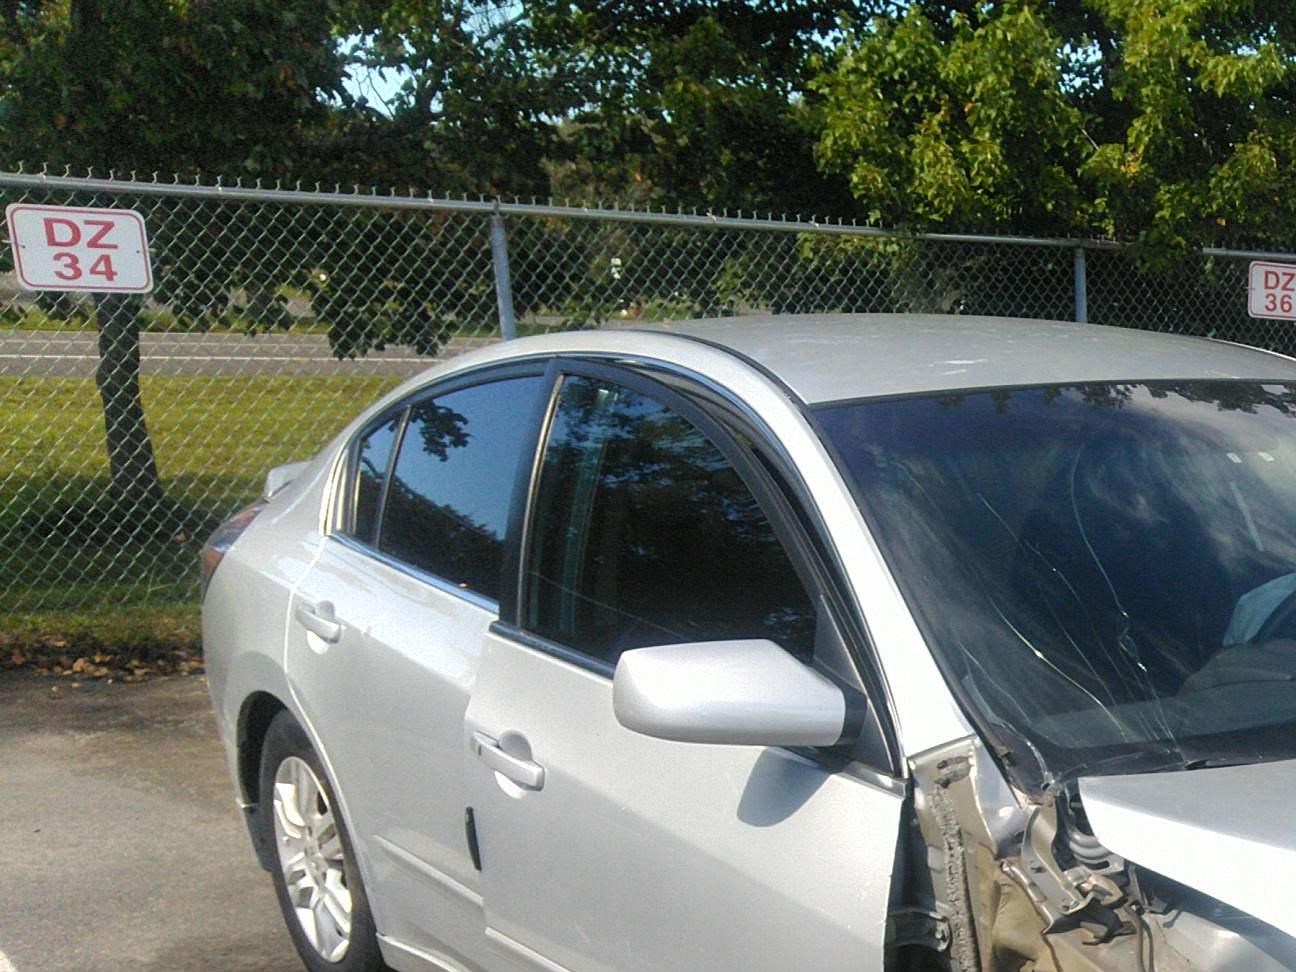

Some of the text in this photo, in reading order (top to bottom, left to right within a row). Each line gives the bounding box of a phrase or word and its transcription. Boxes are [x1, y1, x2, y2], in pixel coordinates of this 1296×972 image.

[43, 218, 119, 249] DZ
[53, 252, 119, 281] 34
[1264, 271, 1296, 291] DZ
[1265, 293, 1293, 313] 36
